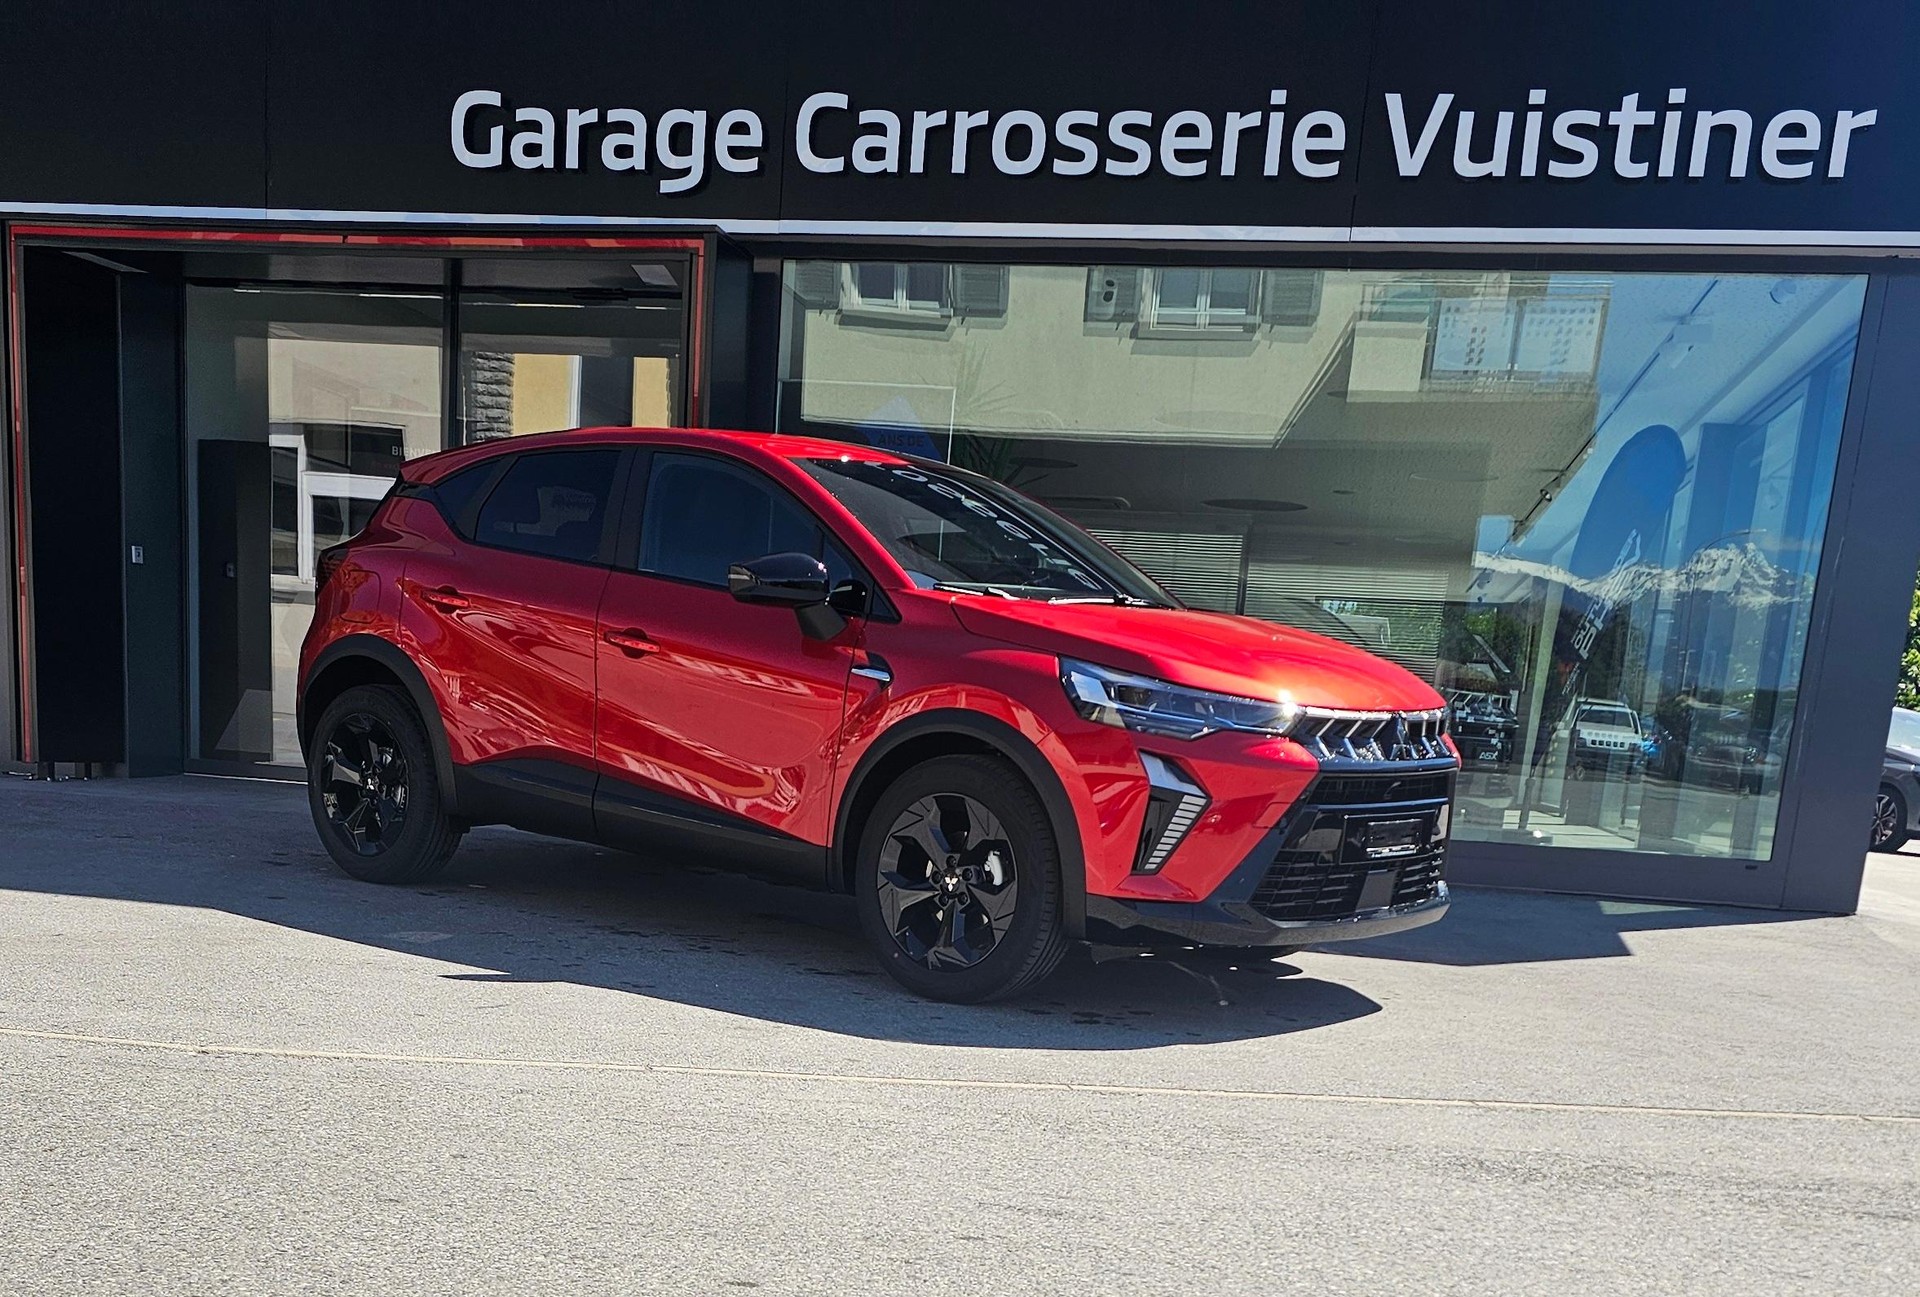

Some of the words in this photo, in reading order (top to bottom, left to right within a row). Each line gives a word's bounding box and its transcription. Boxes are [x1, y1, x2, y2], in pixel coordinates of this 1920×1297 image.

[451, 90, 763, 194] Garage
[795, 89, 1346, 177] Carrosserie
[1384, 87, 1877, 178] Vuistiner
[878, 433, 905, 447] ANS
[907, 434, 925, 447] DE
[1569, 528, 1638, 650] OUTLDER
